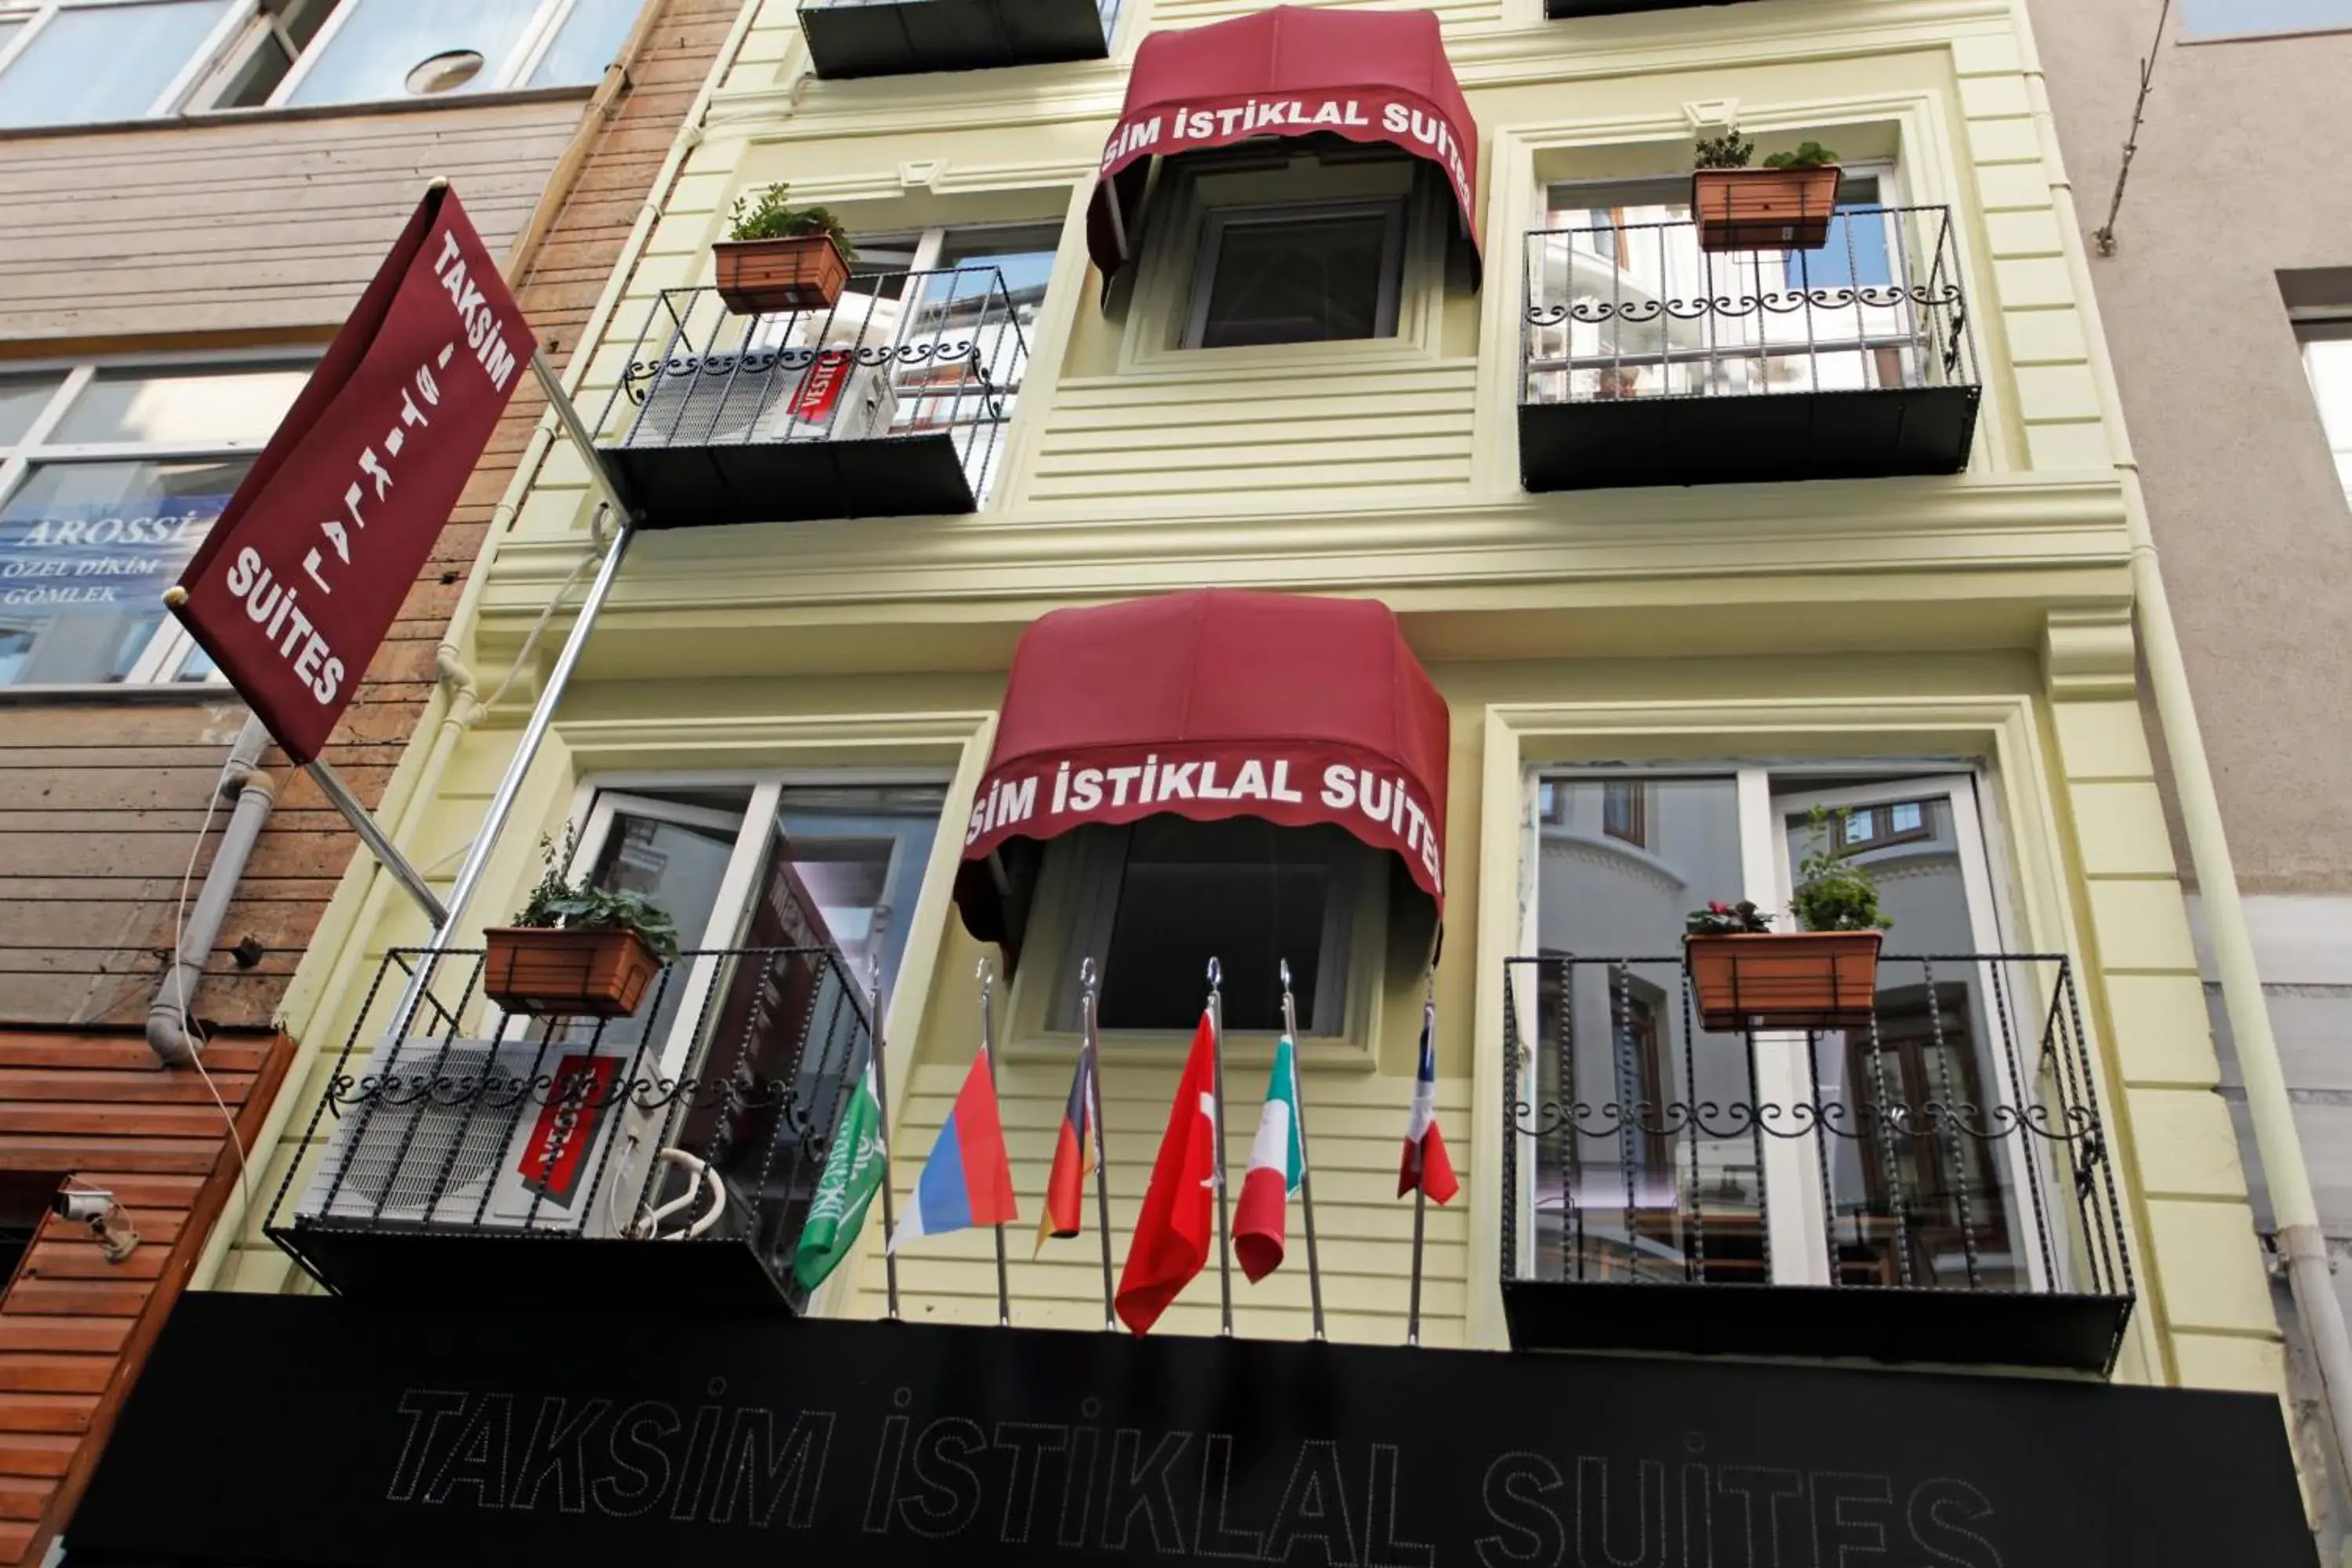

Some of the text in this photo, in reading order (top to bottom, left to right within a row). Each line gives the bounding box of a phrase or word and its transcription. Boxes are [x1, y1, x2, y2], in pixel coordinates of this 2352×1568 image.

[1173, 100, 1369, 139] İSTİKLAL
[434, 229, 516, 392] TAKSİM
[13, 510, 197, 546] AROSSİ
[2, 557, 74, 578] ÖZEL
[4, 585, 122, 604] GÖMLEK
[227, 546, 345, 705] SUİTES
[1051, 753, 1302, 813] İSTİKLAL
[387, 1377, 837, 1528] TAKSİM
[862, 1387, 1436, 1568] İSTİKLAL
